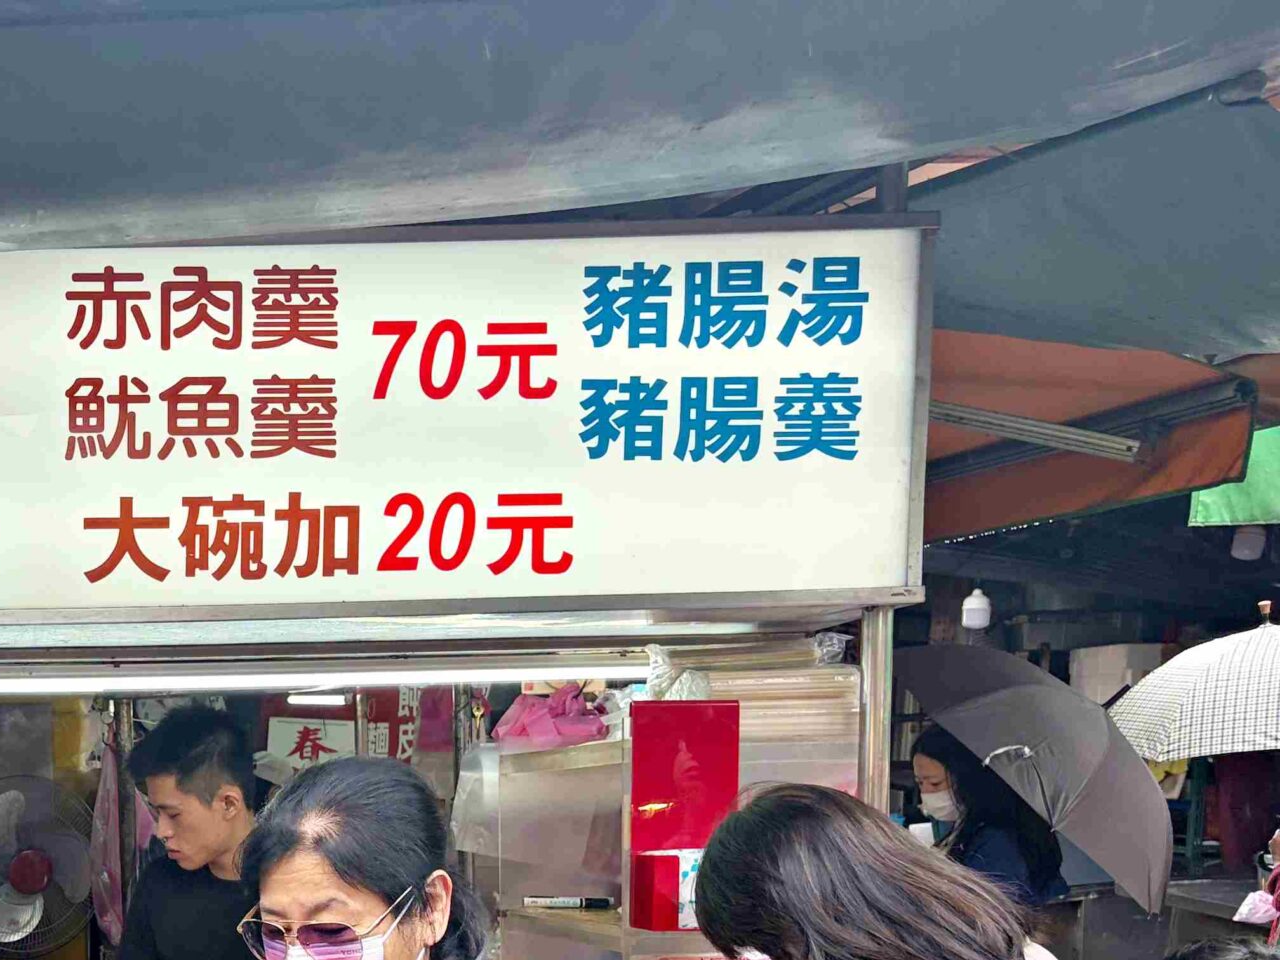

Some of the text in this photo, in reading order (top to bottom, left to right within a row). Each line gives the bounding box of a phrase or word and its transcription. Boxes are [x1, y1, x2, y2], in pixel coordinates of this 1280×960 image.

[66, 265, 339, 351] 赤肉羹
[583, 256, 869, 348] 豬腸湯
[372, 318, 558, 400] 70元
[65, 375, 337, 460] 魷魚羹
[579, 372, 862, 463] 豬腸羹
[286, 725, 338, 766] 春
